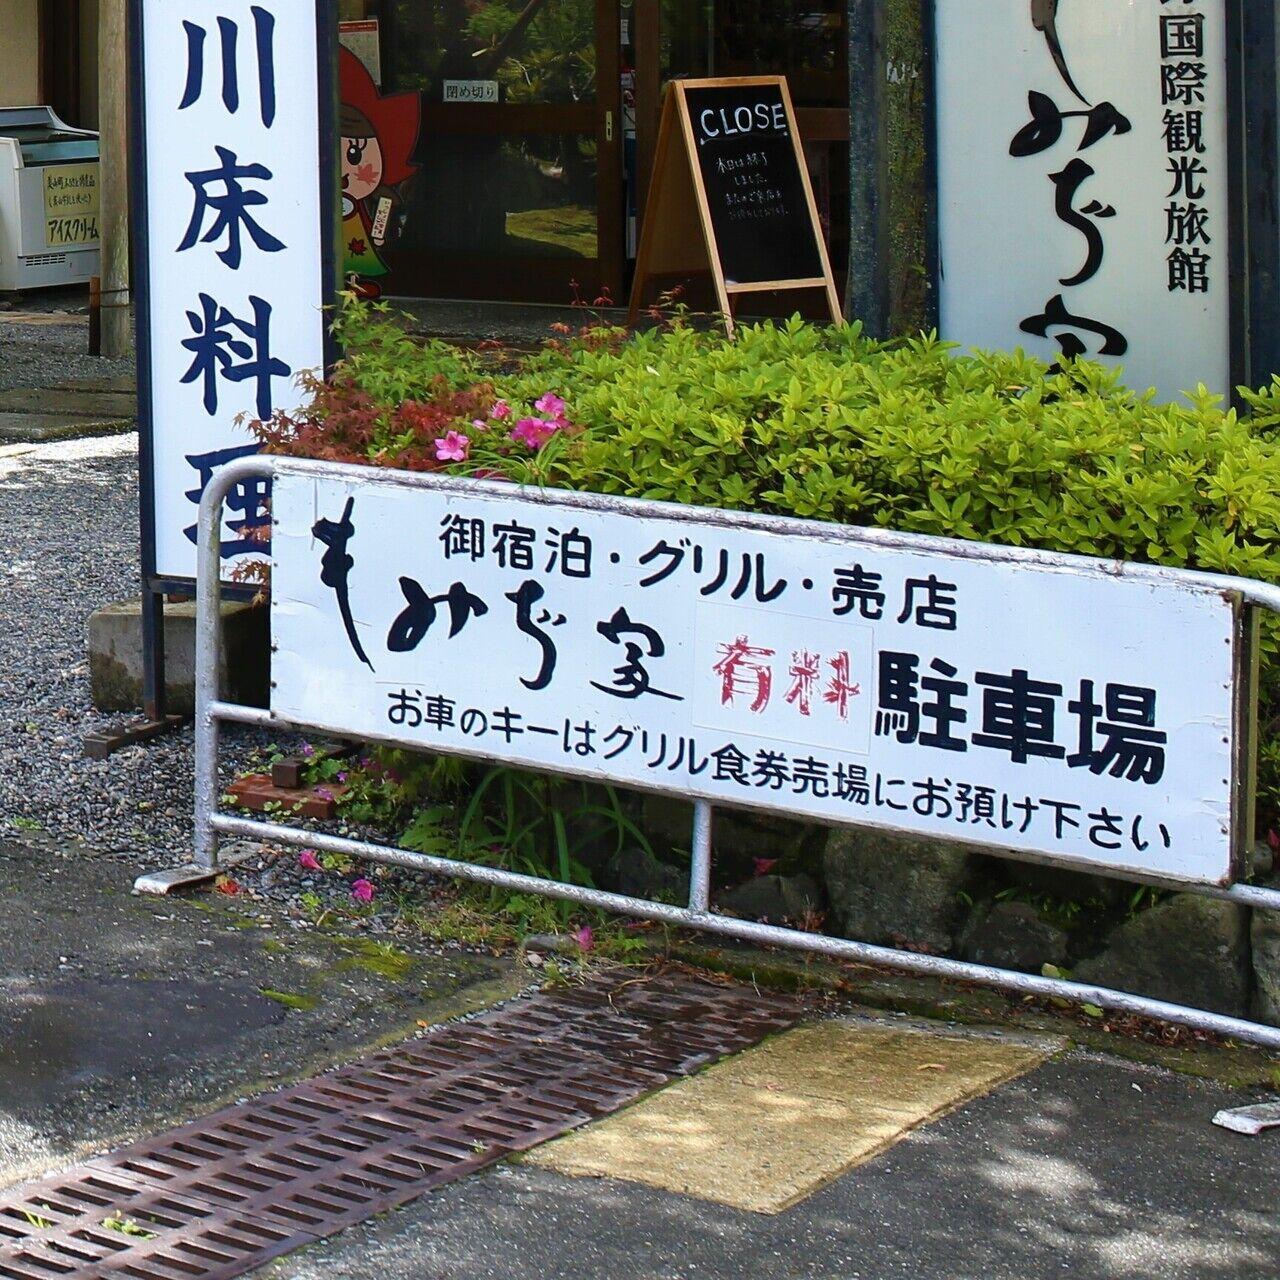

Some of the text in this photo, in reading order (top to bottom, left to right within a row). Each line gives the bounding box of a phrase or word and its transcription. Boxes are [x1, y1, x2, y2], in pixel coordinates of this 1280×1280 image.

[446, 85, 495, 99] 閉め切り
[700, 103, 787, 138] CLOSE
[48, 217, 100, 243] アイスクリーム
[176, 5, 292, 560] 川床料理
[439, 512, 958, 632] 御宿泊・グリル・売店
[711, 633, 1168, 786] 有料 駐車場
[387, 688, 1172, 853] お車のキーはグリル食券売場にお預け下さい
